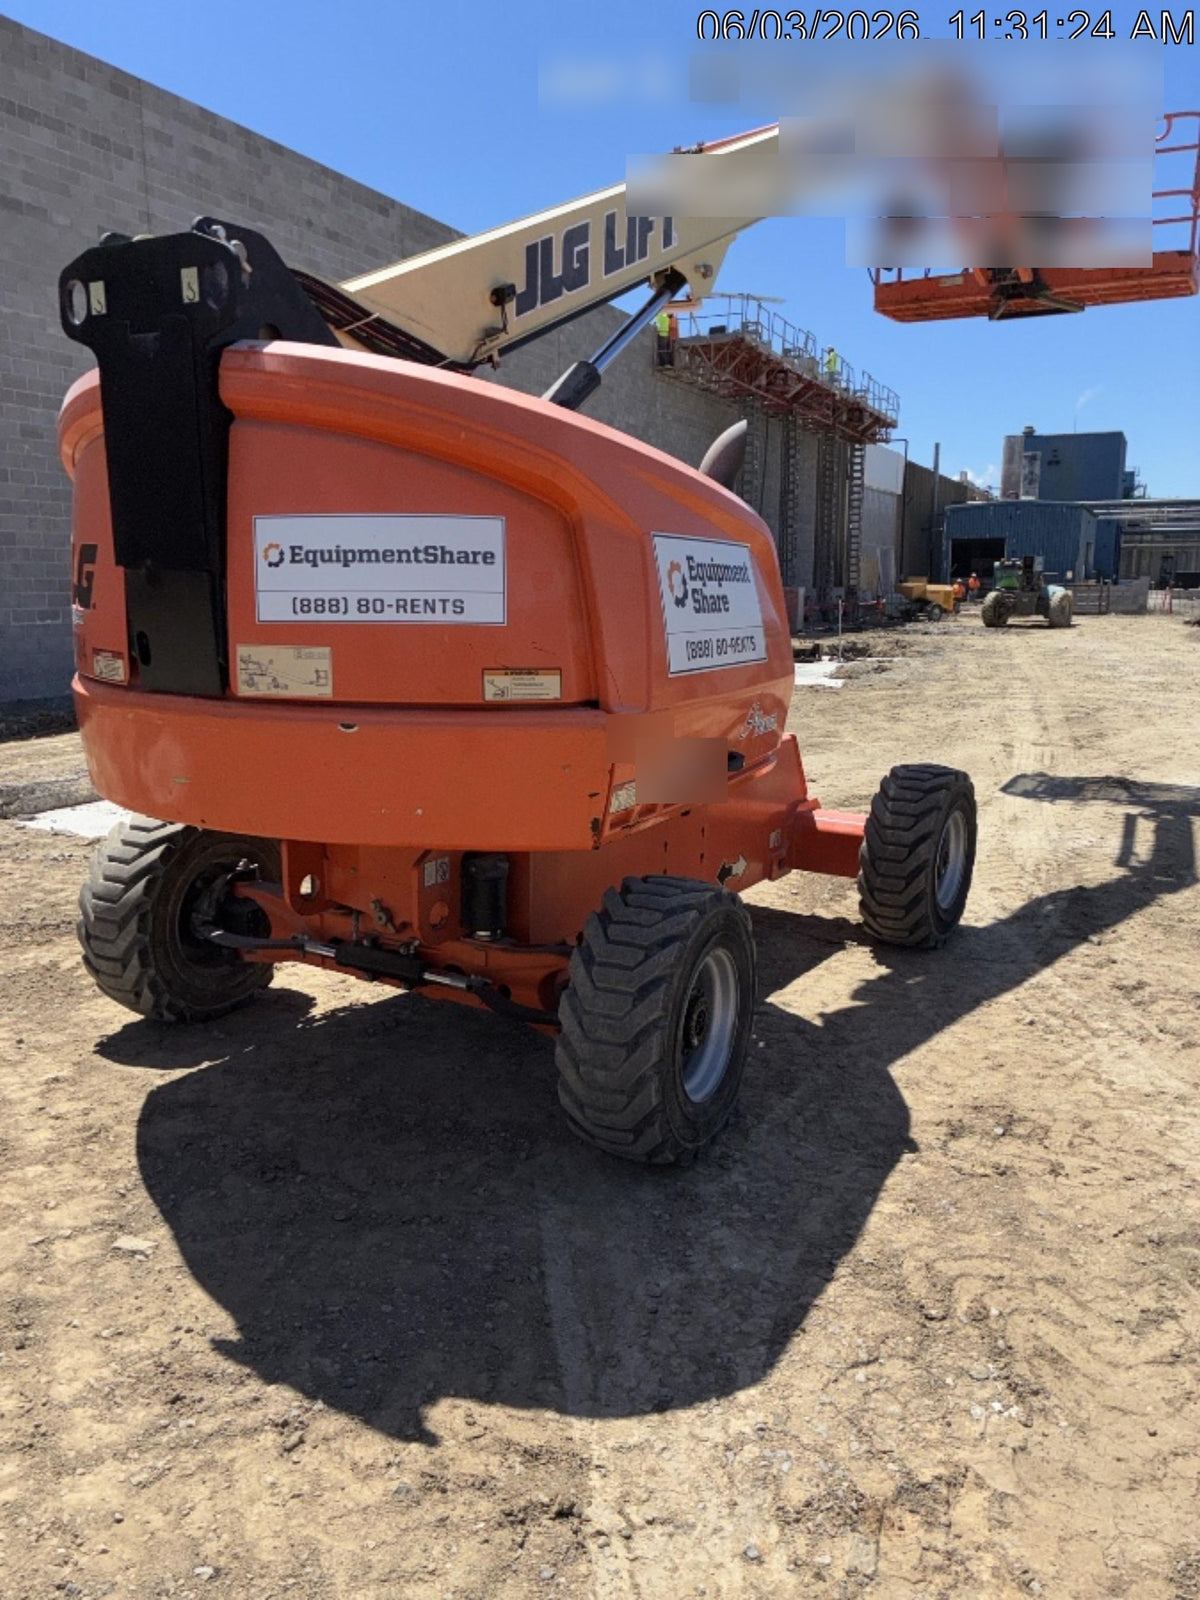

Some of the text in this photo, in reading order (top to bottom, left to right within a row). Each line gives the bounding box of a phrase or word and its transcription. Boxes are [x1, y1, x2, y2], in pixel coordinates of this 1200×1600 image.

[515, 219, 591, 320] JLG
[289, 545, 496, 568] EquipmentShare
[685, 555, 751, 588] Equipment
[291, 597, 466, 615] (888) 80-RENTS
[691, 588, 730, 614] Share
